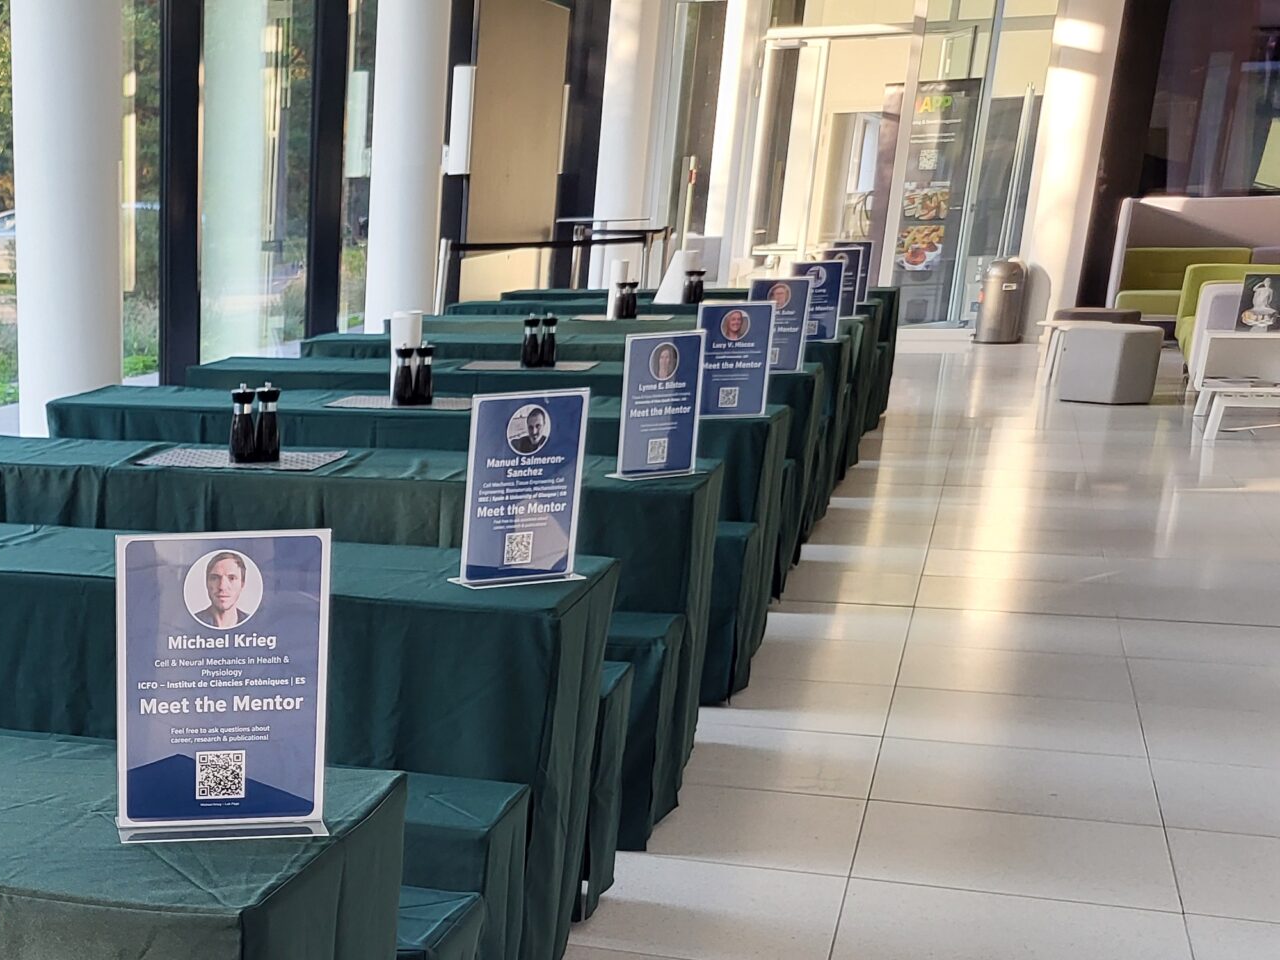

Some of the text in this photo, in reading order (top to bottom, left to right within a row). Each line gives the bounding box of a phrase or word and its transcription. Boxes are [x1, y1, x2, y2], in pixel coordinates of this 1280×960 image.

[722, 361, 734, 369] the
[630, 406, 691, 418] Meet the Mentor
[487, 456, 565, 468] Manuel Salmeron-
[507, 467, 543, 477] Sanchez
[477, 502, 567, 518] Meet the Mentor
[168, 633, 277, 650] Michael Krieg
[154, 659, 169, 668] Cell
[171, 659, 176, 667] &
[179, 658, 204, 667] Neural
[206, 657, 246, 666] Mechanics
[256, 656, 282, 664] Health
[201, 669, 242, 677] Physiology
[138, 682, 158, 690] ICFO
[167, 680, 196, 689] Institut
[198, 680, 208, 688] de
[139, 694, 304, 715] Meet the Mentor
[220, 726, 250, 734] questions
[194, 735, 221, 743] research
